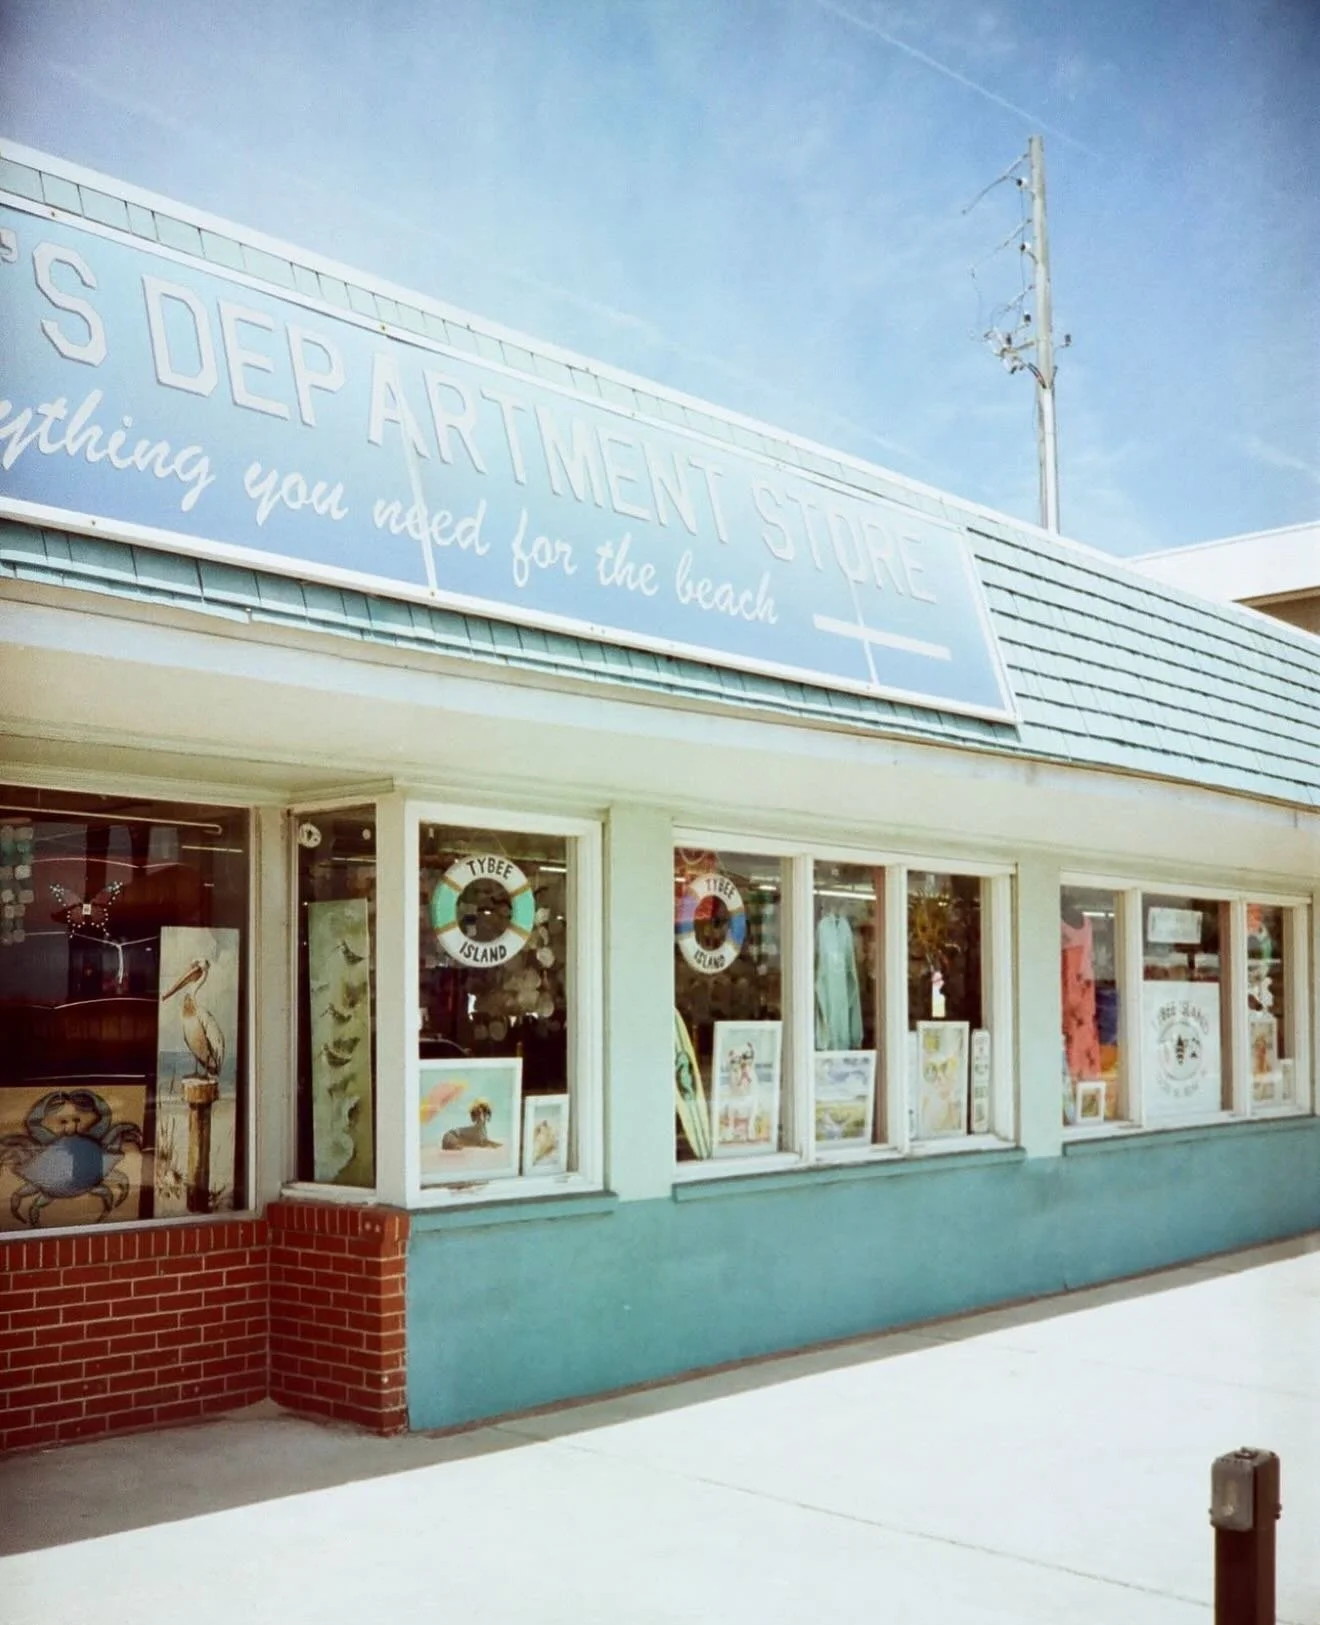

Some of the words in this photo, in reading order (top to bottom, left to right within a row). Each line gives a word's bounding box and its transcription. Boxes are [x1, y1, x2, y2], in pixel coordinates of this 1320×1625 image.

[142, 275, 726, 543] DEPARTMENT
[752, 482, 938, 604] STORE
[244, 456, 349, 527] you
[373, 498, 491, 555] need
[511, 507, 577, 589] for
[596, 531, 660, 597] the
[675, 549, 779, 625] beach
[466, 855, 515, 881] TYBEE
[706, 877, 735, 900] TYBEE
[459, 942, 508, 963] ISLAND
[693, 949, 725, 969] ISLAND
